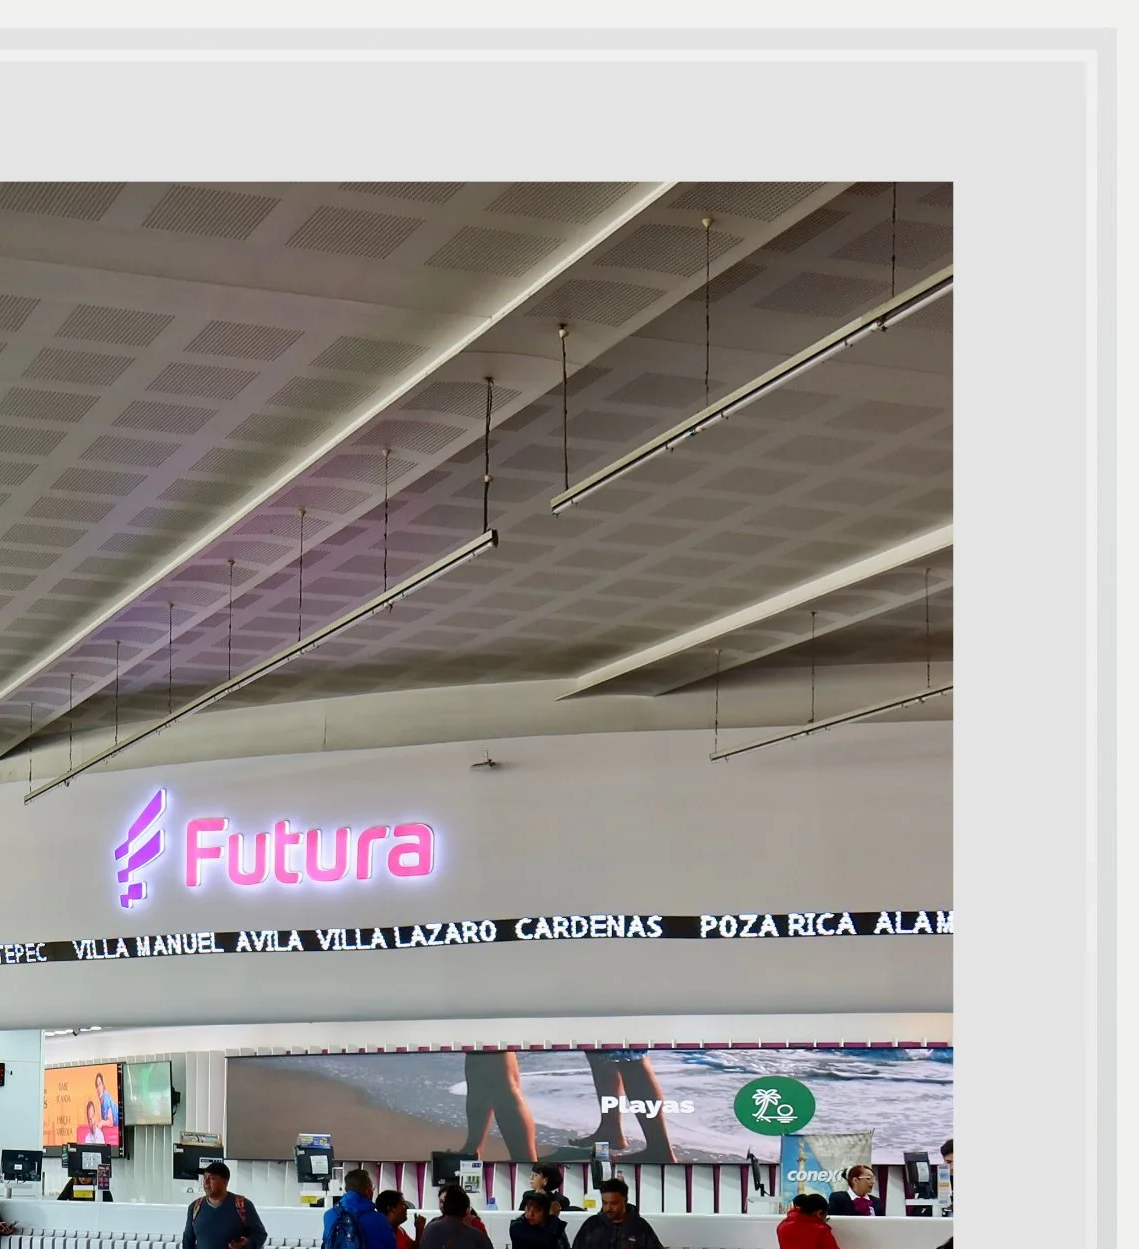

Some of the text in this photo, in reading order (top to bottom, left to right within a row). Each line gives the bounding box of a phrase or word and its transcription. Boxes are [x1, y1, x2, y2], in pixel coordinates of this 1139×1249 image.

[185, 816, 434, 887] Futura
[71, 937, 130, 960] VILLA
[135, 931, 224, 957] MANUEL
[235, 930, 304, 952] AVILA
[315, 927, 388, 951] VILLA
[393, 919, 497, 948] LAZARO
[514, 914, 663, 940] CARDENAS
[699, 913, 780, 938] POZA
[787, 911, 857, 936] RICA
[601, 1095, 695, 1119] Playas
